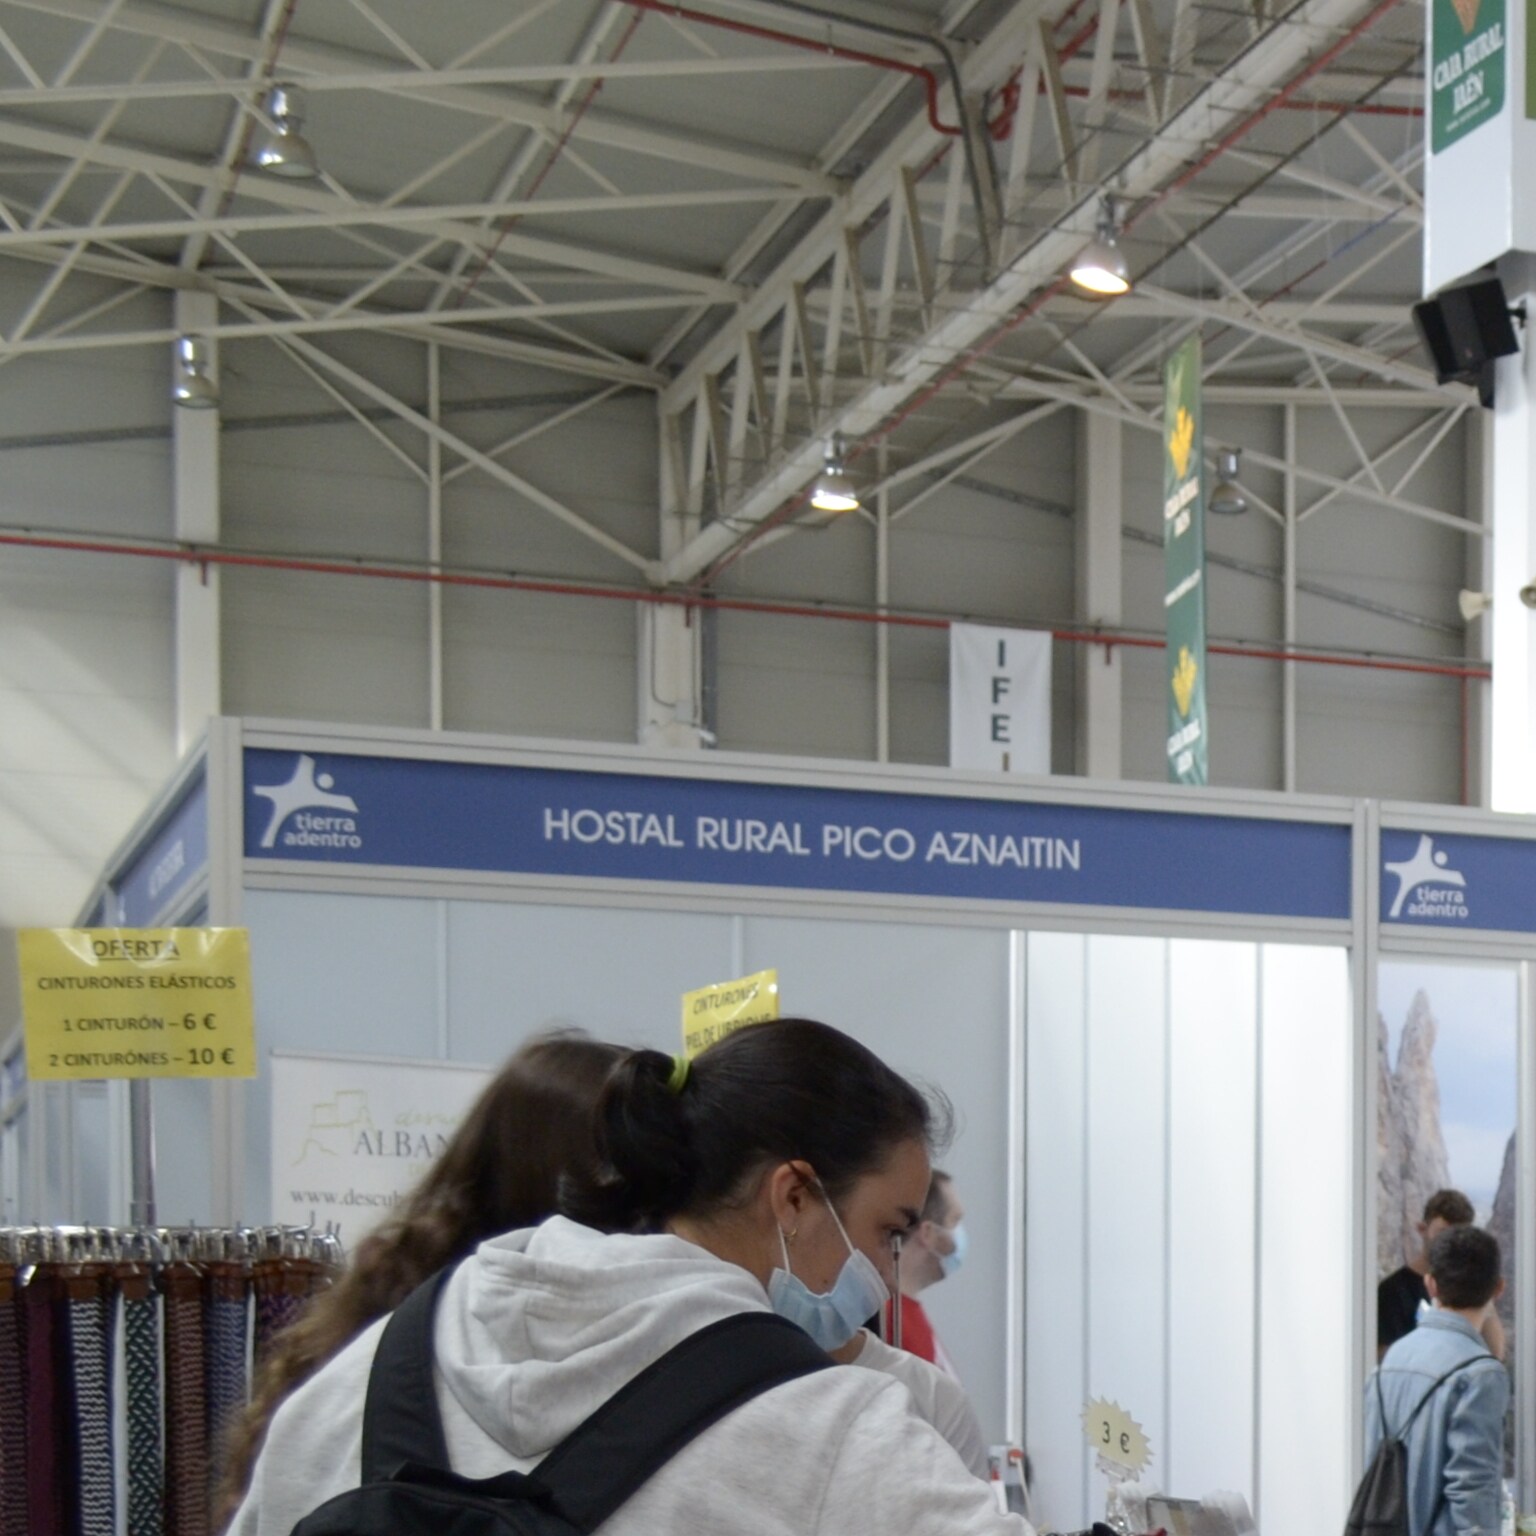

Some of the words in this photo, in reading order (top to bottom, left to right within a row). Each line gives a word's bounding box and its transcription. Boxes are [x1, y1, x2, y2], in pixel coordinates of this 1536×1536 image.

[295, 813, 356, 832] tierra
[284, 830, 362, 848] adentro
[543, 808, 683, 848] HOSTAL
[697, 816, 809, 855] RURAL
[822, 825, 916, 862] PICO
[926, 831, 1081, 871] AZNAITIN
[1416, 887, 1464, 903] tierra
[1407, 901, 1469, 918] adentro
[92, 940, 180, 959] OFERTA
[38, 975, 145, 990] CINTURONES
[149, 973, 236, 989] ELÁSTICOS
[63, 1019, 72, 1032] 1
[77, 1016, 164, 1031] CINTURÓN
[183, 1014, 196, 1030] 6
[203, 1013, 217, 1030] €
[49, 1054, 59, 1067] 2
[64, 1051, 169, 1067] CINTURÓNES
[189, 1048, 214, 1065] 10
[221, 1048, 235, 1065] €
[1102, 1421, 1111, 1444] 3
